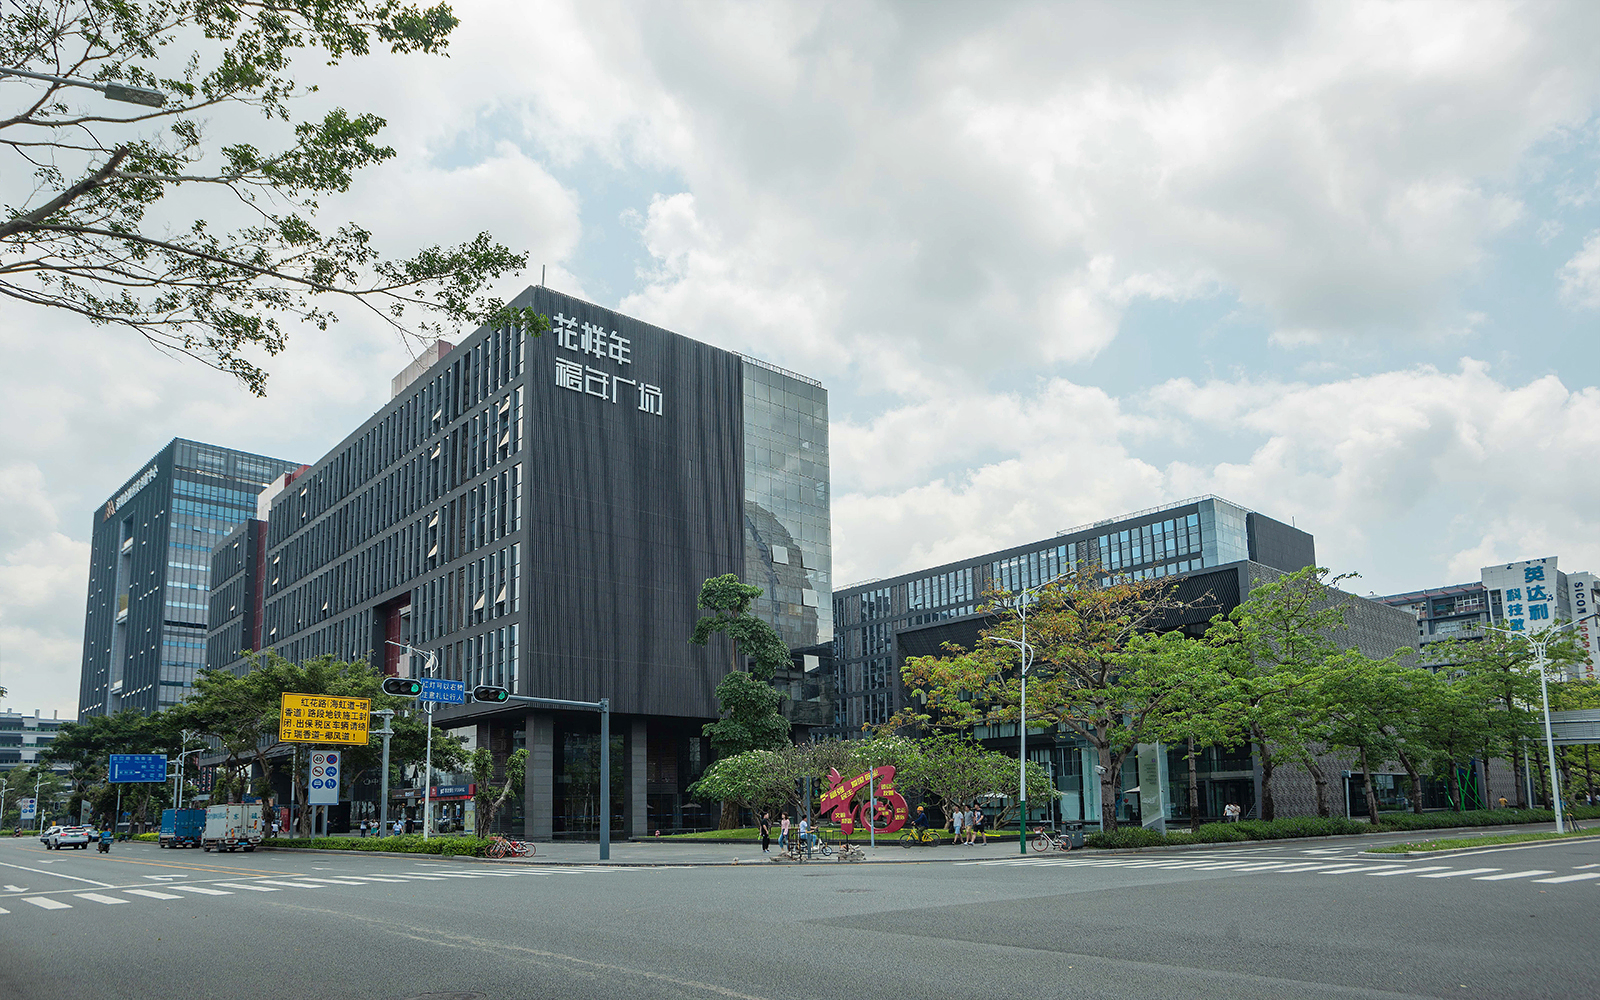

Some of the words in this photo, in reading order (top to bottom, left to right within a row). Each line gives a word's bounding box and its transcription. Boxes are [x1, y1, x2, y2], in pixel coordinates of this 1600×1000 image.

[553, 312, 631, 365] 花样年
[1524, 565, 1549, 621] 英达利
[422, 691, 462, 702] 注意礼让行人
[423, 681, 463, 692] 红灯可以右转
